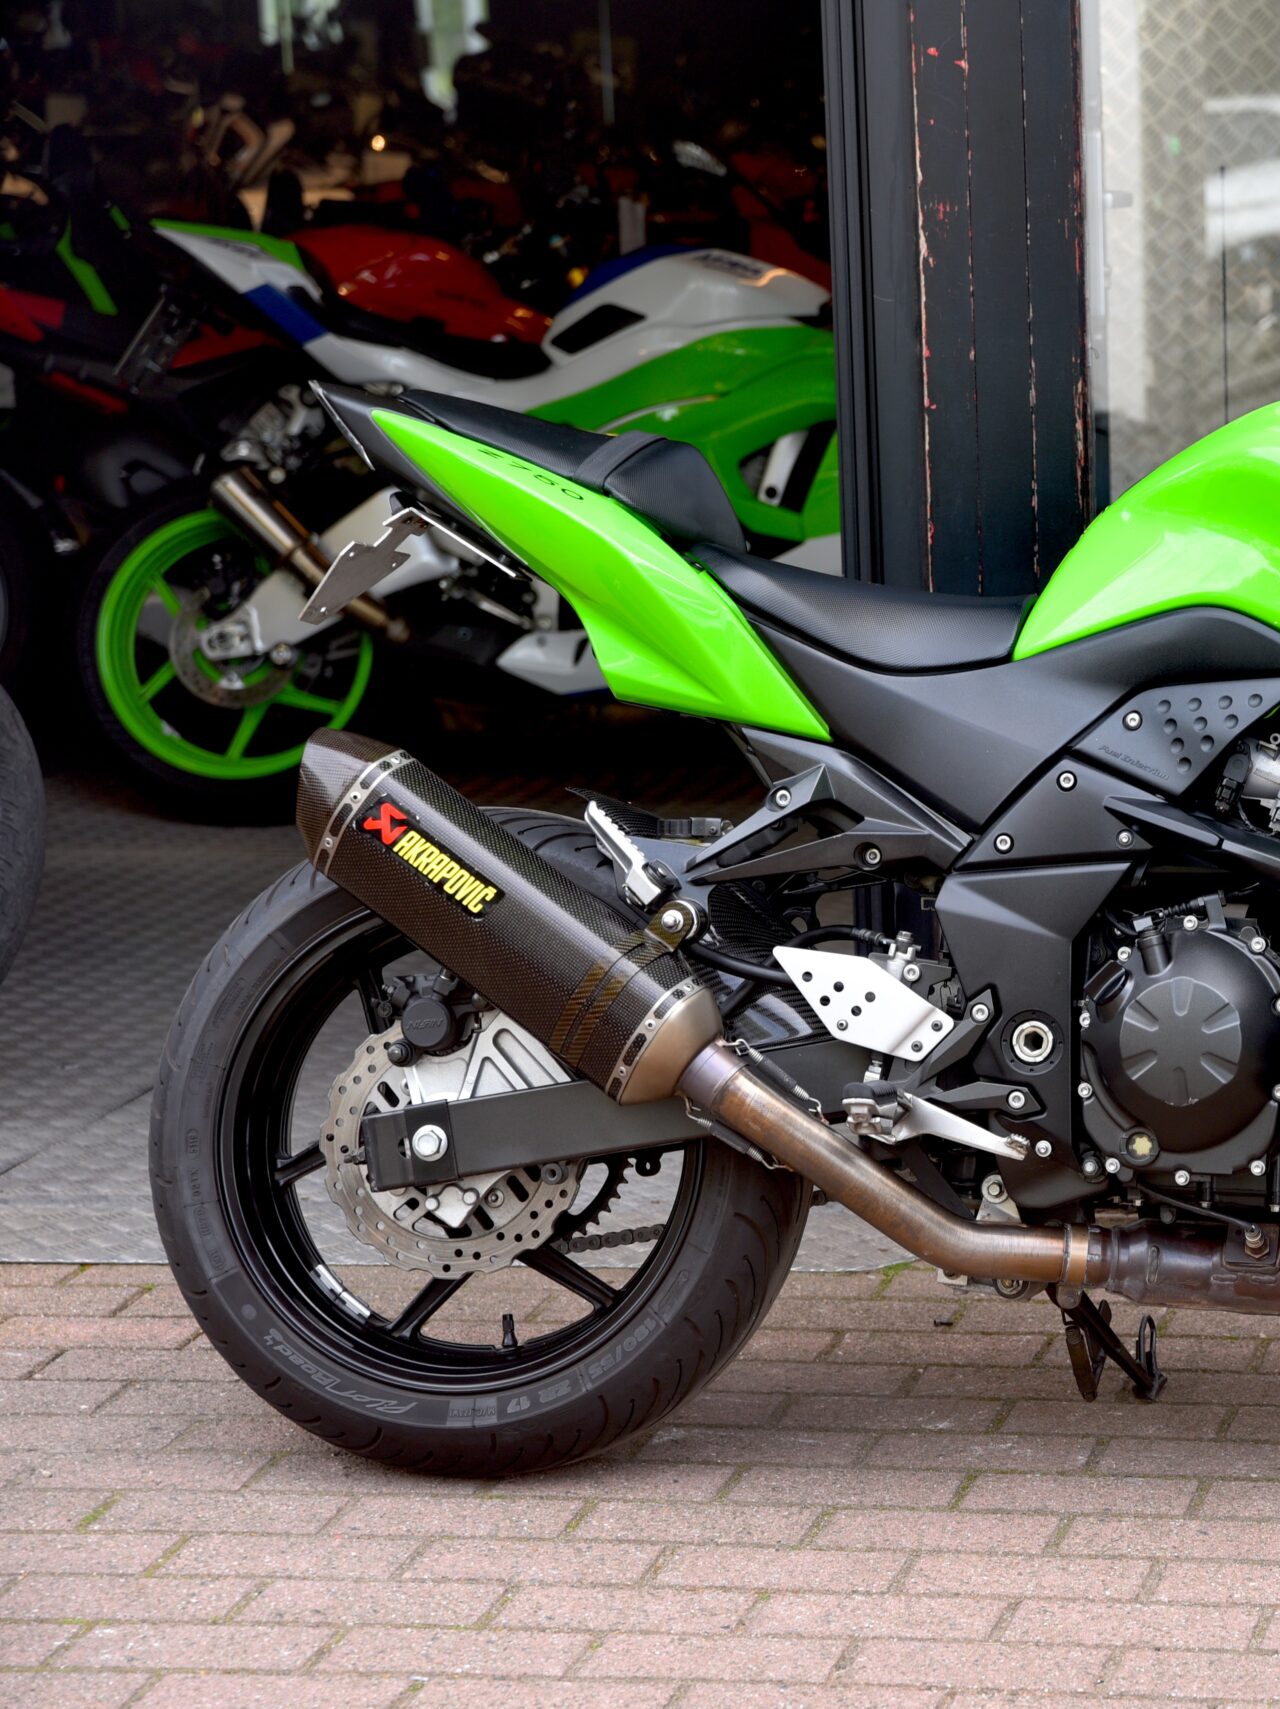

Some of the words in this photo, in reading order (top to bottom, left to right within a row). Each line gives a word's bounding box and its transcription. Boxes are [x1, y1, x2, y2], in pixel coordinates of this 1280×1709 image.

[392, 830, 497, 914] AKRAPOVIČ
[588, 1317, 657, 1380] 180/55
[506, 1396, 530, 1415] 17
